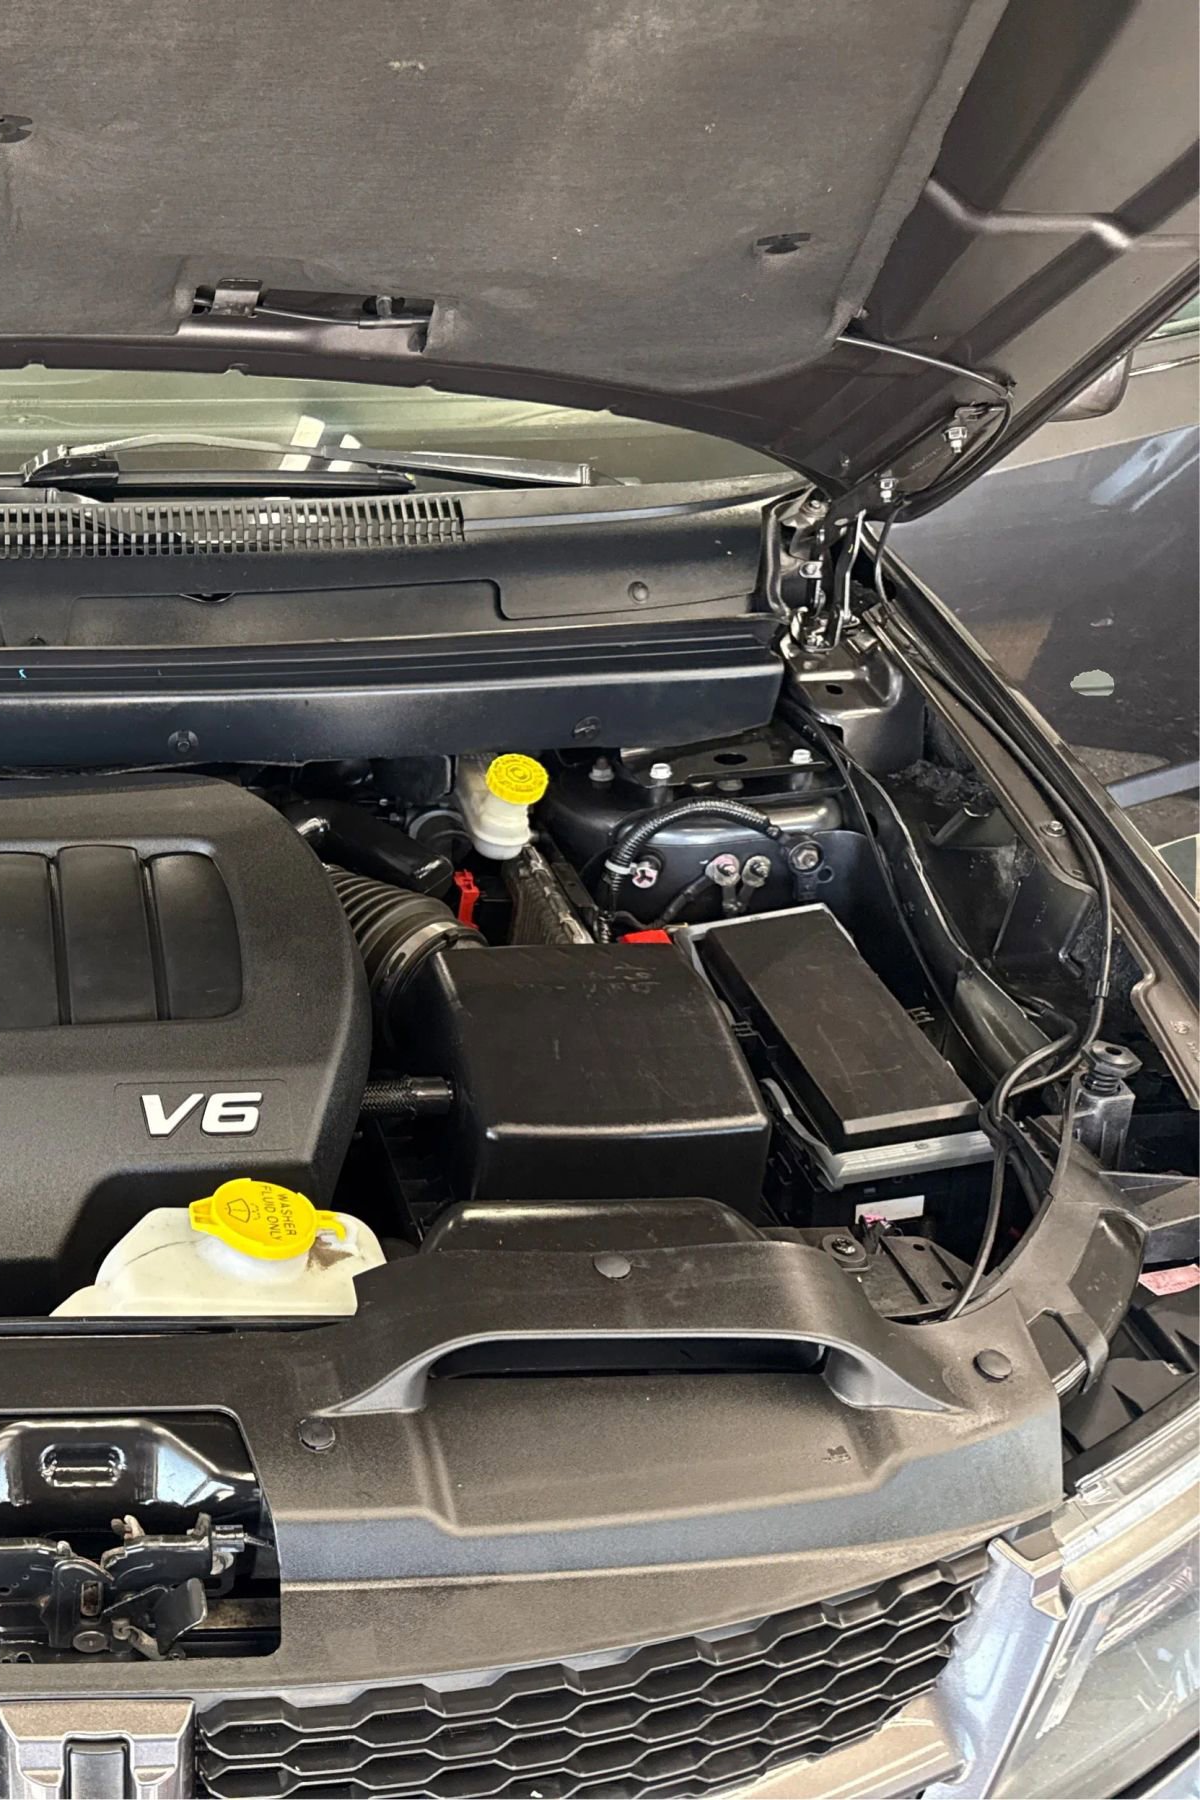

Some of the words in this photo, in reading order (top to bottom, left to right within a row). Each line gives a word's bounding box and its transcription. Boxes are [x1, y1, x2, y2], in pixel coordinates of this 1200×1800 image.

[141, 1091, 263, 1137] V6
[261, 1185, 277, 1213] FLUID
[277, 1193, 297, 1236] WASHER
[266, 1215, 282, 1240] ONLY
